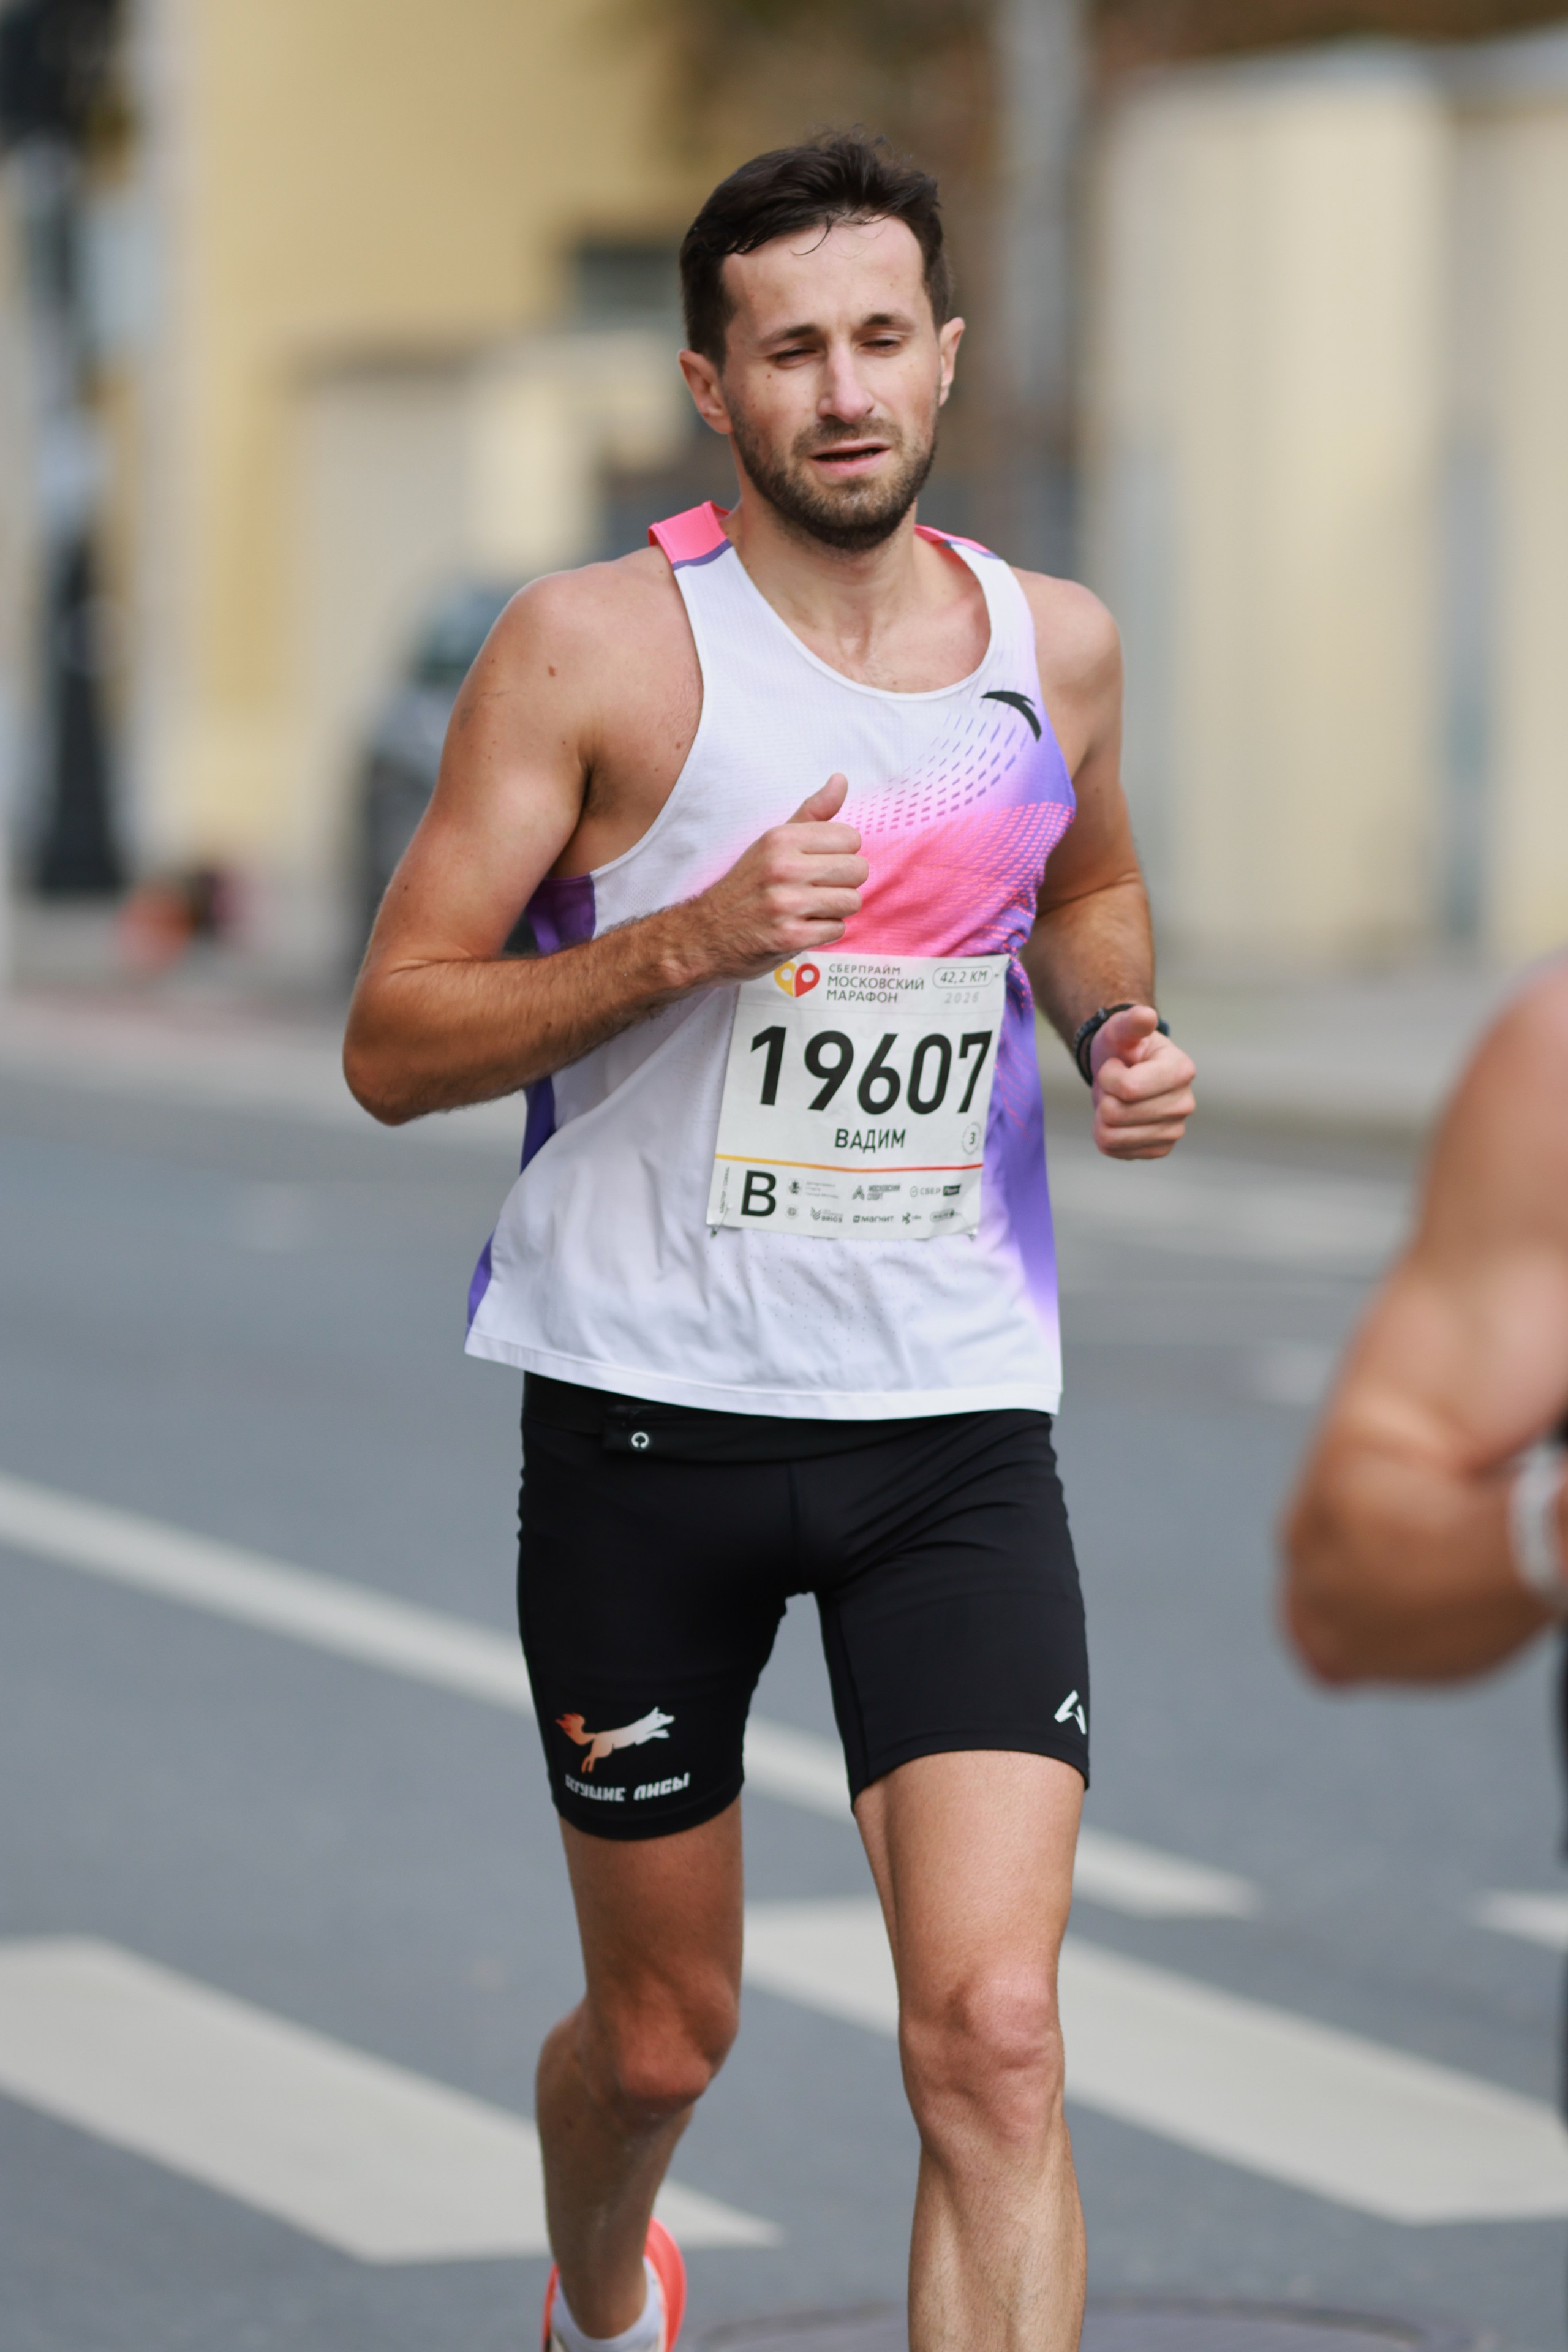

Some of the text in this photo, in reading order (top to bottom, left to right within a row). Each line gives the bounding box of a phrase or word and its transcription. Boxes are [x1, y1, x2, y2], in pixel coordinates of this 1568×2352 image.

[829, 963, 900, 975] СБЕРПРАЙМ
[827, 976, 924, 990] МОСКОВСКИЙ
[940, 971, 967, 984] 42,2
[827, 989, 898, 1003] МАРАФОН
[750, 1025, 993, 1115] 19607
[835, 1128, 907, 1154] ВАДИМ
[920, 1186, 941, 1196] СБЕР
[633, 1771, 690, 1801] ЛИСЫ
